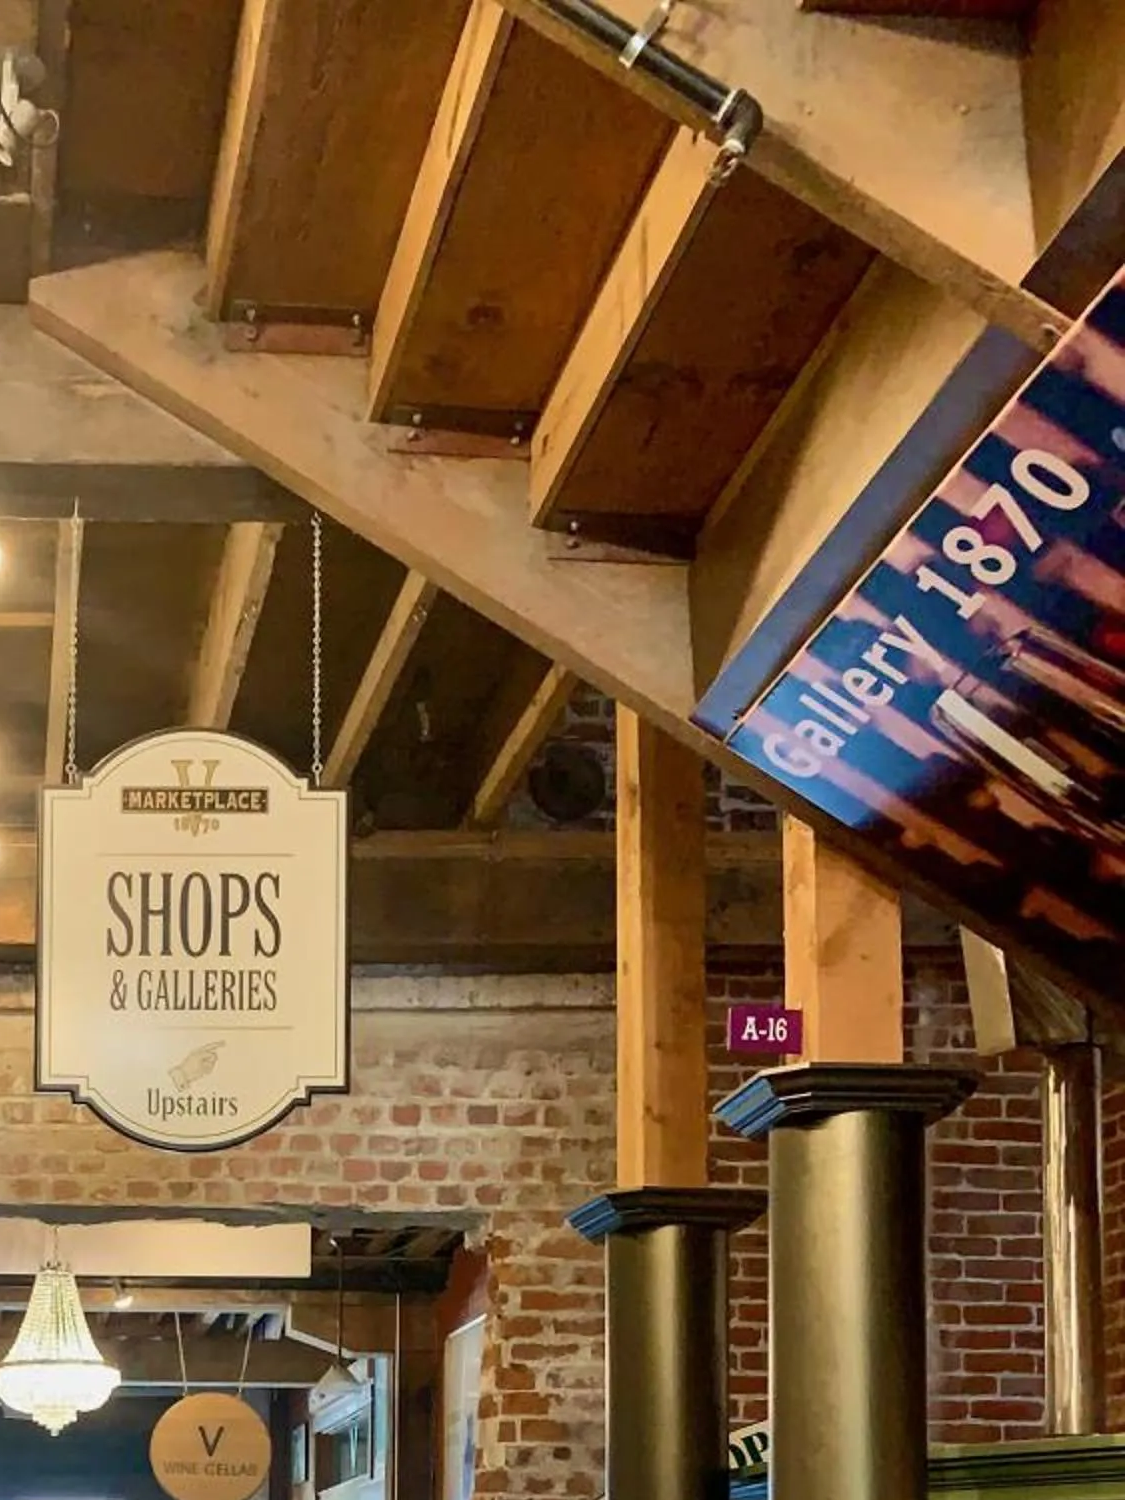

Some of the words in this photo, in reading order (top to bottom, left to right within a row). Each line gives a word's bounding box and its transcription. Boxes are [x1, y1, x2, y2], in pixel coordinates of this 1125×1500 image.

[763, 614, 960, 779] Gallery
[915, 448, 1091, 620] 1870
[127, 790, 263, 811] MARKETPLACE
[106, 871, 282, 958] SHOPS
[110, 970, 129, 1011] &
[137, 969, 277, 1012] GALLERIES
[741, 1015, 788, 1042] A-16
[146, 1088, 239, 1119] Upstairs
[198, 1426, 224, 1457] V
[163, 1461, 200, 1475] WINE
[204, 1462, 258, 1477] CELLAR
